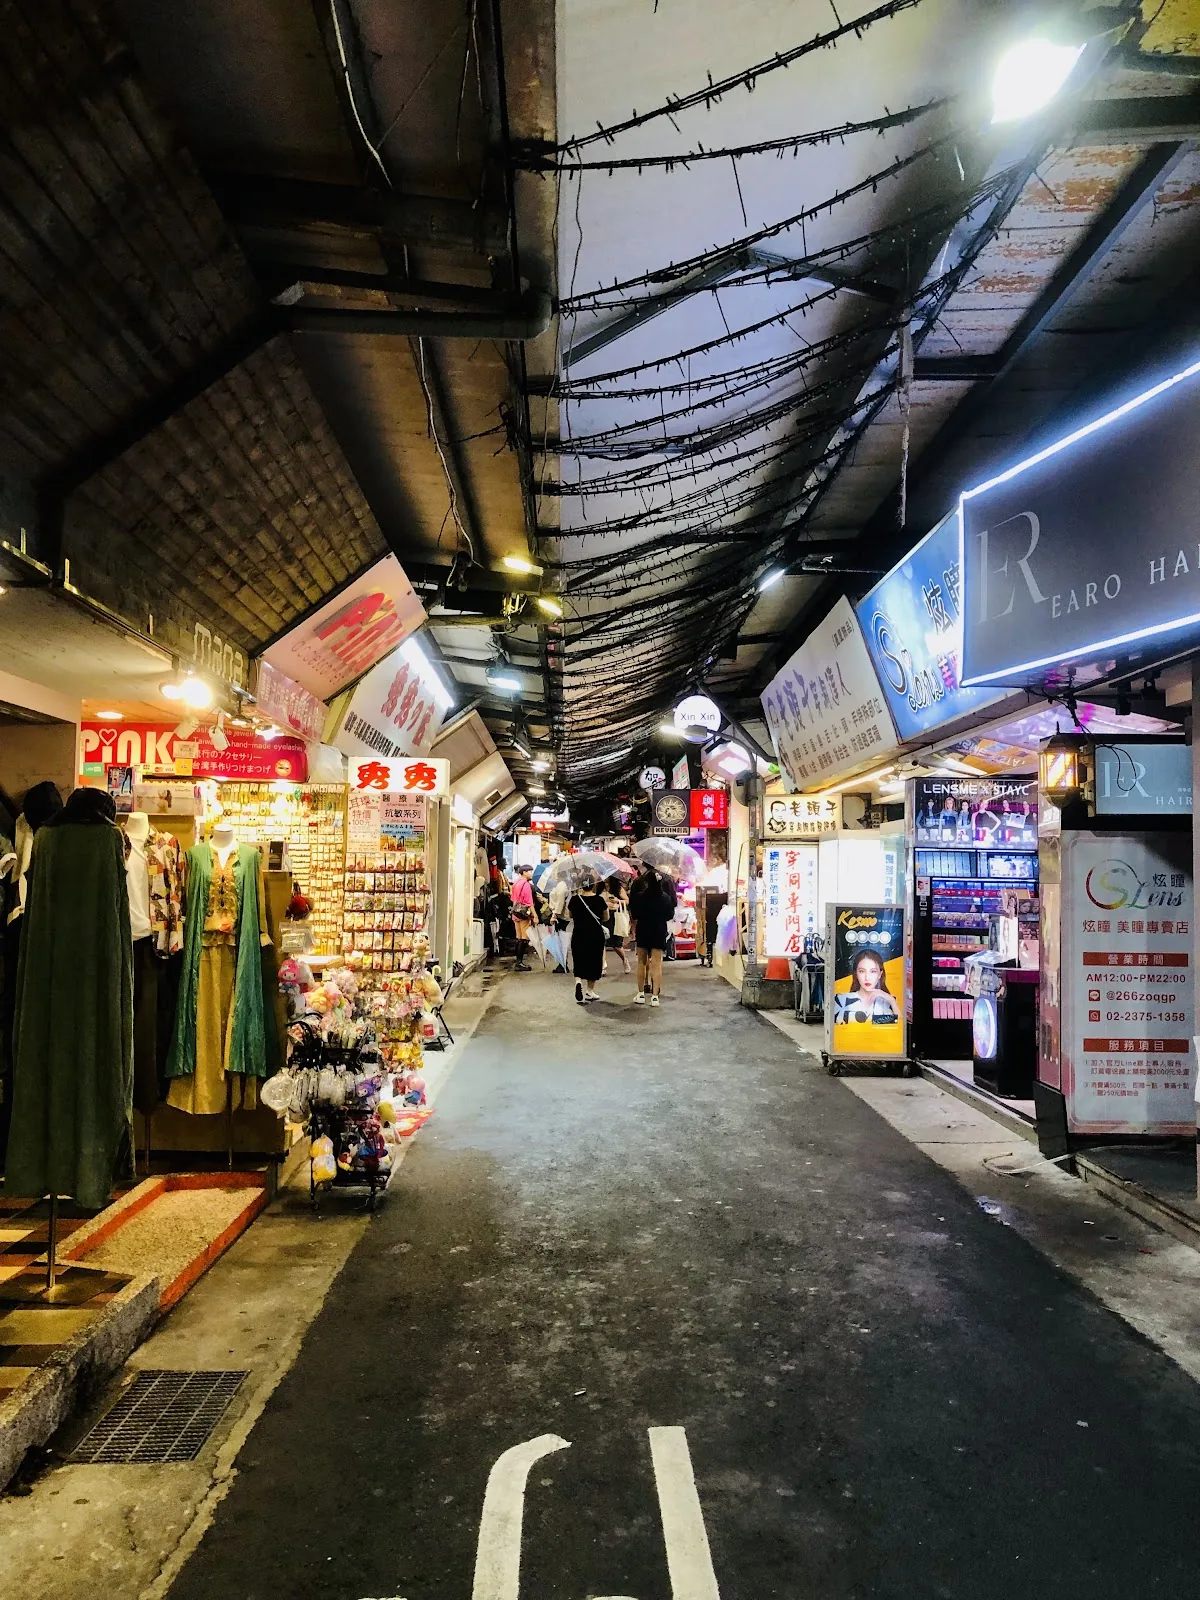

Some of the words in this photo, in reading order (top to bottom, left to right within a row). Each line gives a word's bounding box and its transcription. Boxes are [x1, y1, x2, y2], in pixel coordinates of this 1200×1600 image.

[1052, 574, 1122, 619] EARO
[1149, 543, 1200, 585] HA
[680, 712, 696, 721] Xin
[700, 712, 716, 721] Xin
[356, 761, 437, 792] 秀秀
[923, 783, 978, 795] LENSME
[993, 784, 1029, 796] STAYC
[1156, 796, 1192, 806] HAIR
[789, 799, 838, 817] 老頭子
[1152, 873, 1186, 888] 炫瞳
[1082, 919, 1112, 933] 炫瞳
[1107, 954, 1164, 966] 營業時間
[1106, 1011, 1186, 1022] 02-2375-1358
[1108, 1040, 1164, 1052] 服務項目
